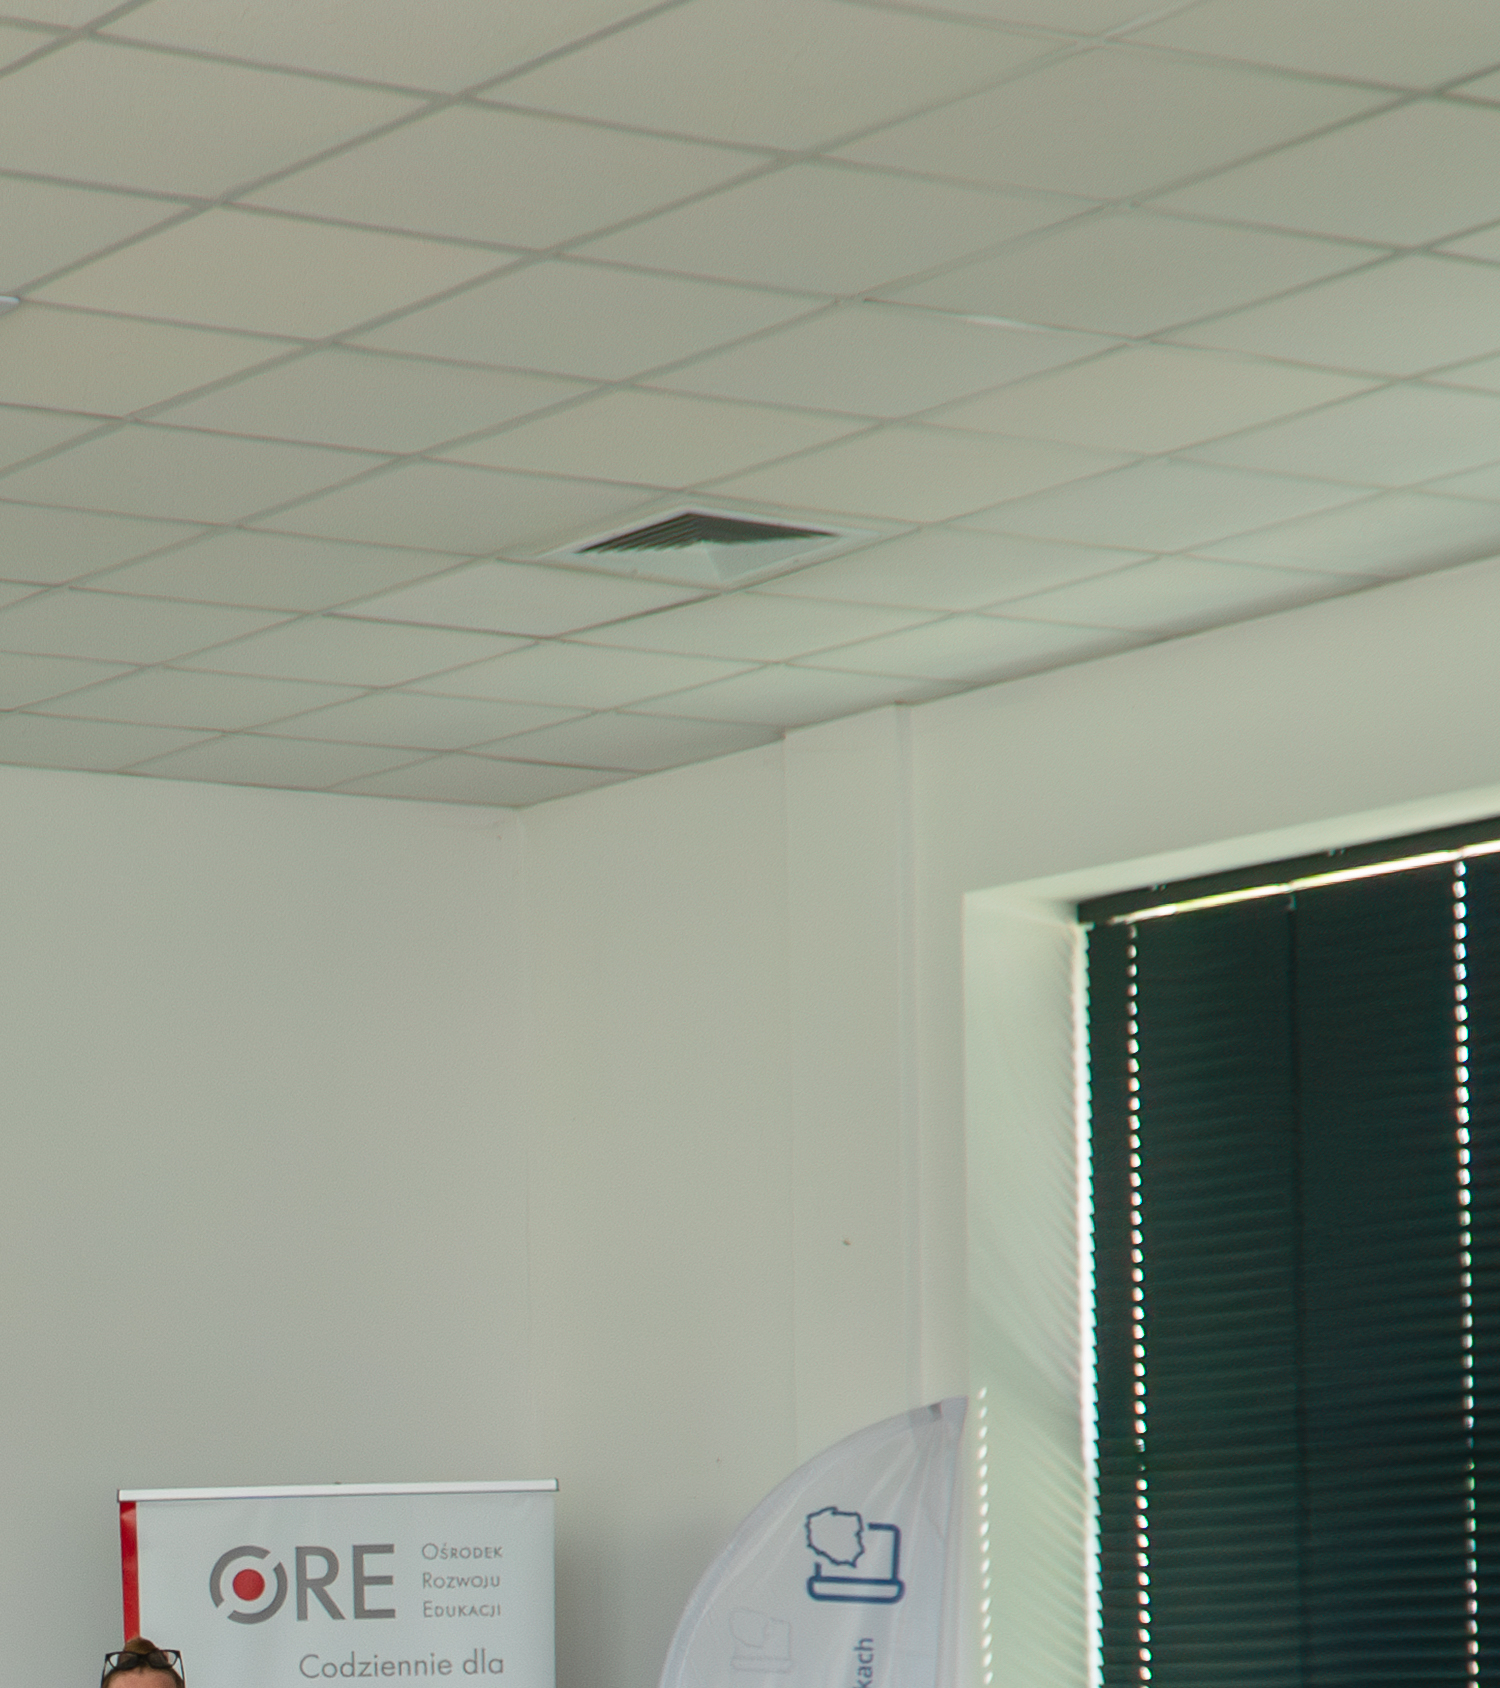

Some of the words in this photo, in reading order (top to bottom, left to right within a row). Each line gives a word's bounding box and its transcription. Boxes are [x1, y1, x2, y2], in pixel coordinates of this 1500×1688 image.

[420, 1542, 503, 1561] OŚRODEK
[421, 1571, 501, 1590] ROZWOJU
[422, 1599, 502, 1619] EDUKACJI
[298, 1650, 453, 1681] Codziennie
[461, 1647, 505, 1676] dla
